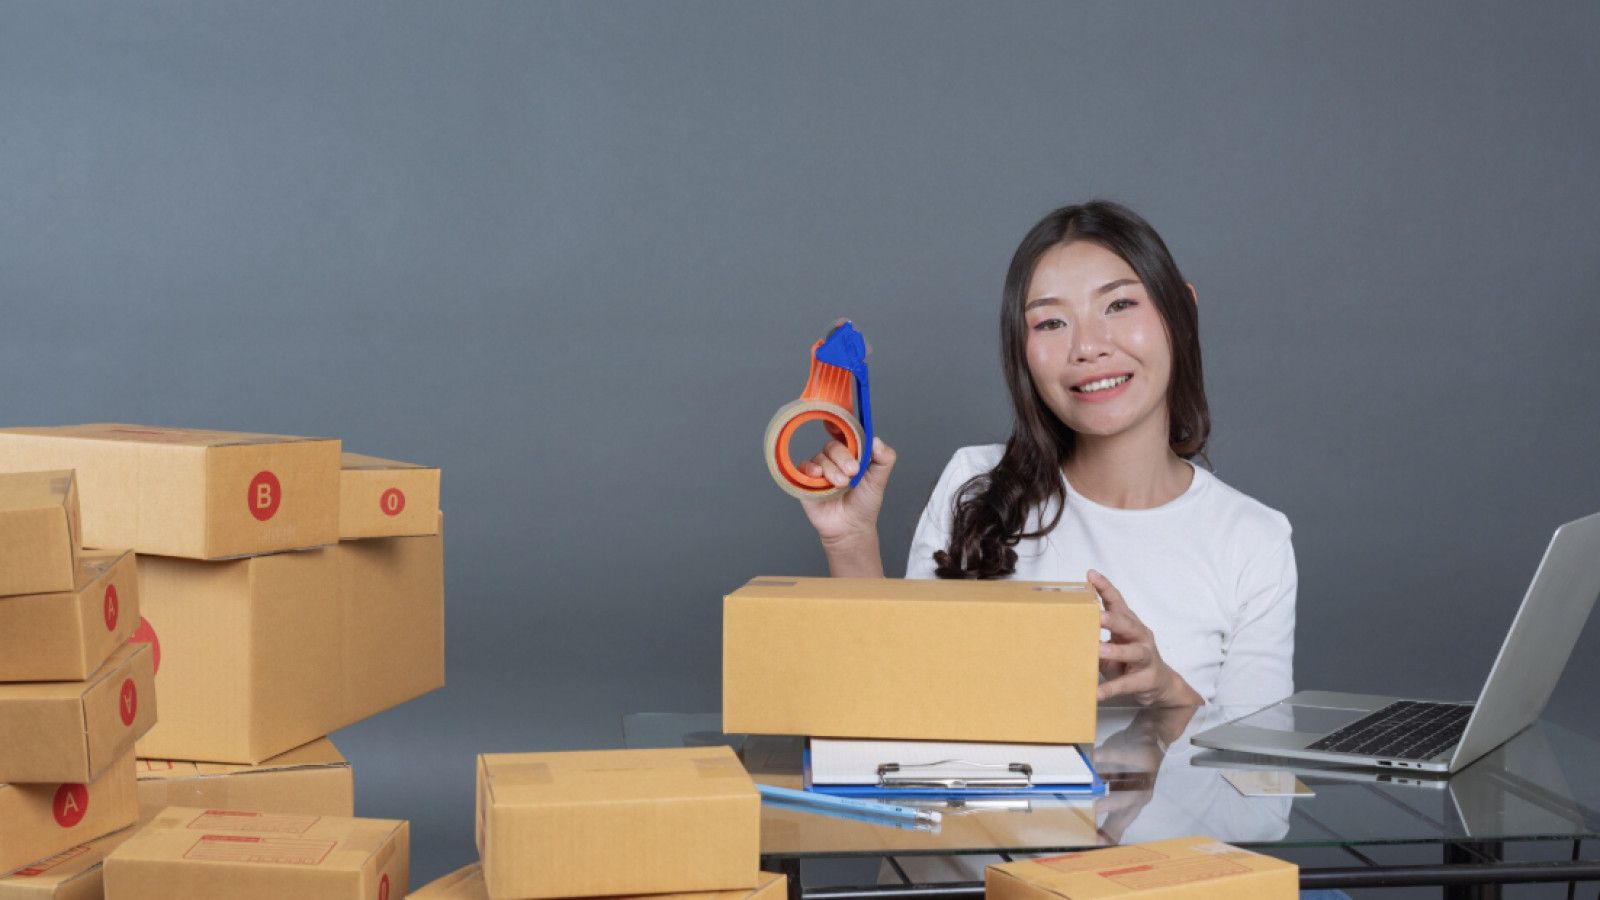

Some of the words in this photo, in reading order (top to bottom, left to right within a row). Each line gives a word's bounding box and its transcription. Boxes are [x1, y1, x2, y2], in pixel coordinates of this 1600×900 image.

[257, 483, 271, 509] B
[108, 596, 116, 620] A
[63, 791, 79, 817] A
